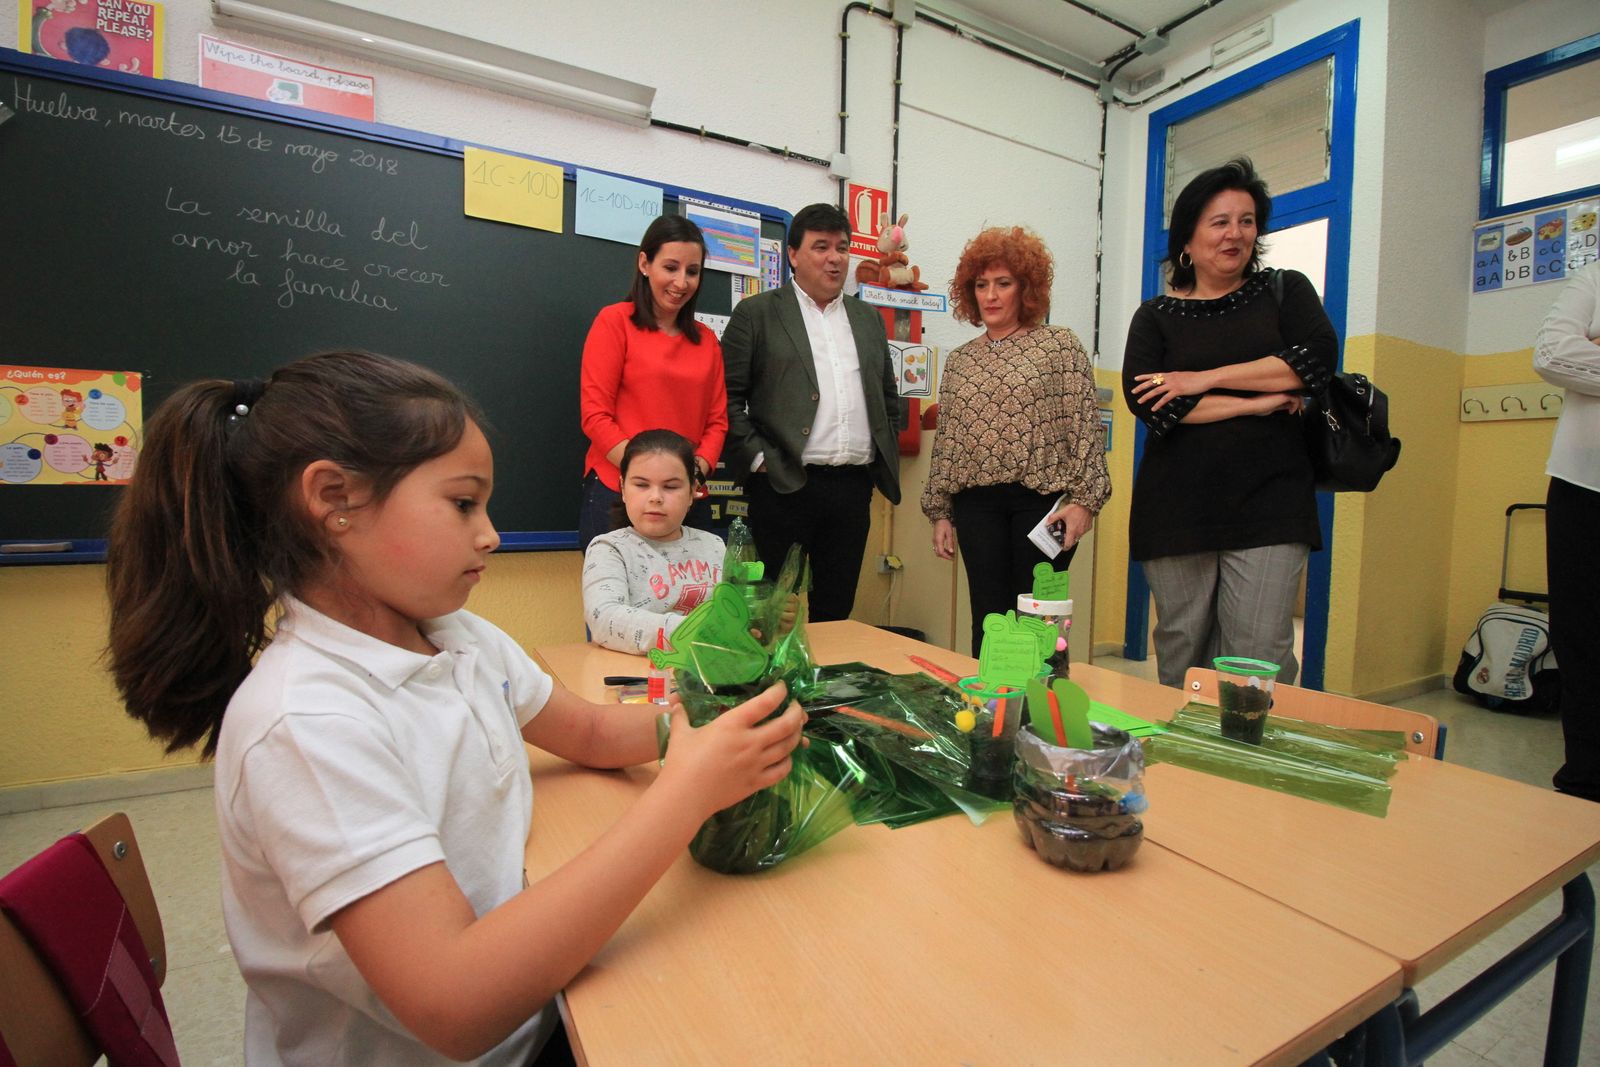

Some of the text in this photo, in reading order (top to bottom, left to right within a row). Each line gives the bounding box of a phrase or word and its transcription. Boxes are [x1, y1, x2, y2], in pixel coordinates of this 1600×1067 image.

[97, 0, 151, 16] CAN YOU
[96, 19, 153, 42] PLEASE?
[206, 42, 246, 62] Wipe
[250, 53, 274, 69] the
[119, 109, 206, 140] martes
[216, 125, 242, 144] 15
[247, 131, 273, 151] de
[285, 143, 339, 174] mayo
[349, 149, 399, 175] 2018
[165, 186, 429, 250] La semilla del
[171, 232, 450, 287] amor hace crecer
[226, 259, 398, 312] la familia
[7, 369, 44, 379] ¿Quién
